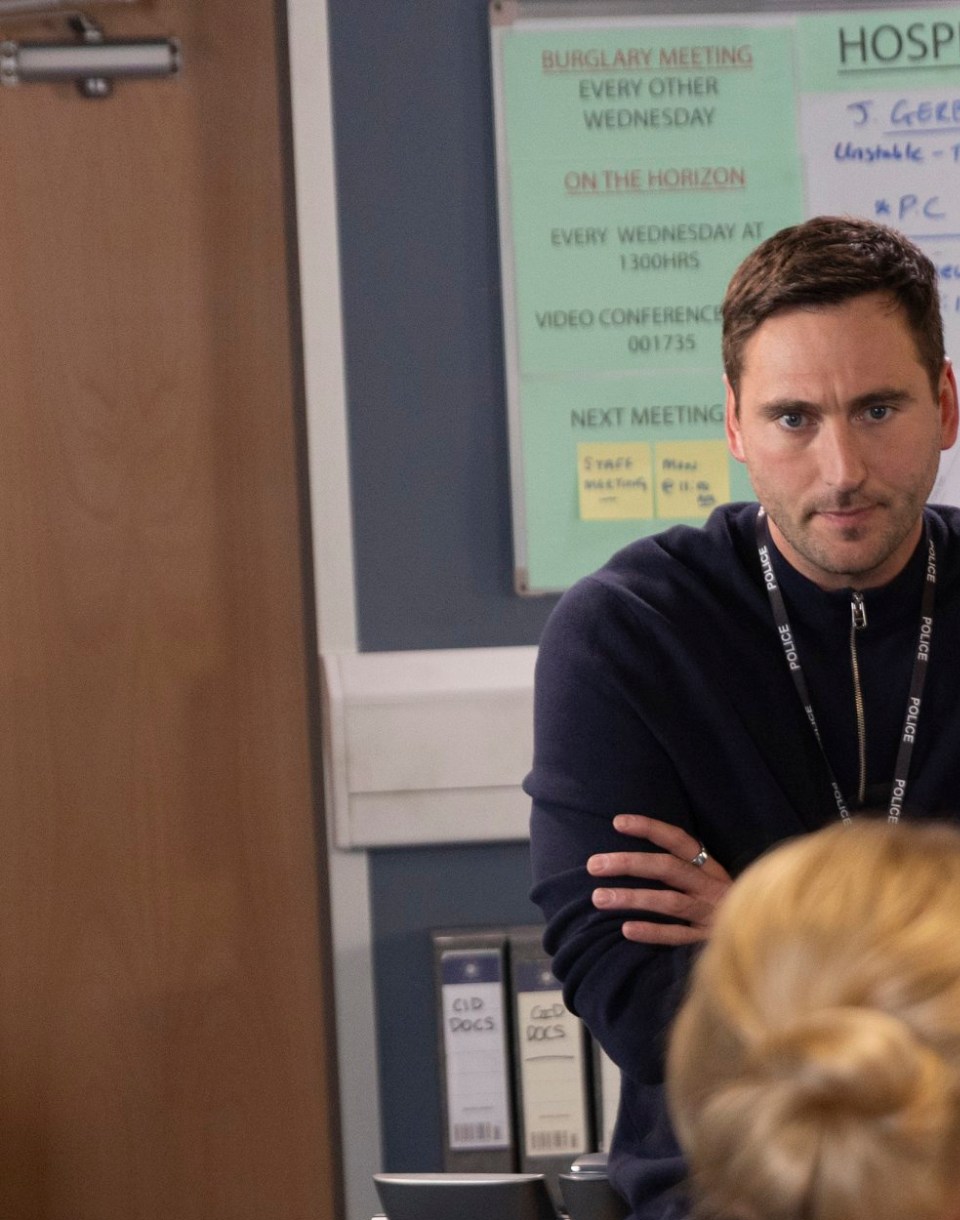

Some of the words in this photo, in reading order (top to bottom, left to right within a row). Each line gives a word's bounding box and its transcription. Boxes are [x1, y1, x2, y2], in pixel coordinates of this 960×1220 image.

[541, 48, 652, 69] BURGLARY
[659, 45, 753, 66] MEETING
[579, 78, 643, 99] EVERY
[649, 76, 719, 97] OTHER
[584, 106, 715, 130] WEDNESDAY
[564, 170, 597, 190] ON
[603, 169, 641, 188] THE
[649, 166, 745, 187] HORIZON
[551, 227, 608, 247] EVERY
[617, 223, 736, 244] WEDNESDAY
[742, 221, 764, 239] AT
[620, 252, 700, 271] 1300HRS
[535, 308, 593, 328] VIDEO
[628, 333, 696, 353] 001735
[571, 408, 625, 427] NEXT
[758, 545, 777, 591] POLICE
[778, 624, 801, 670] POLICE
[917, 616, 933, 662] POLICE
[903, 696, 921, 744] POLICE
[888, 778, 906, 825] POLICE
[452, 996, 485, 1012] CID
[450, 1016, 495, 1034] DOCS
[527, 1024, 567, 1041] DOCS
